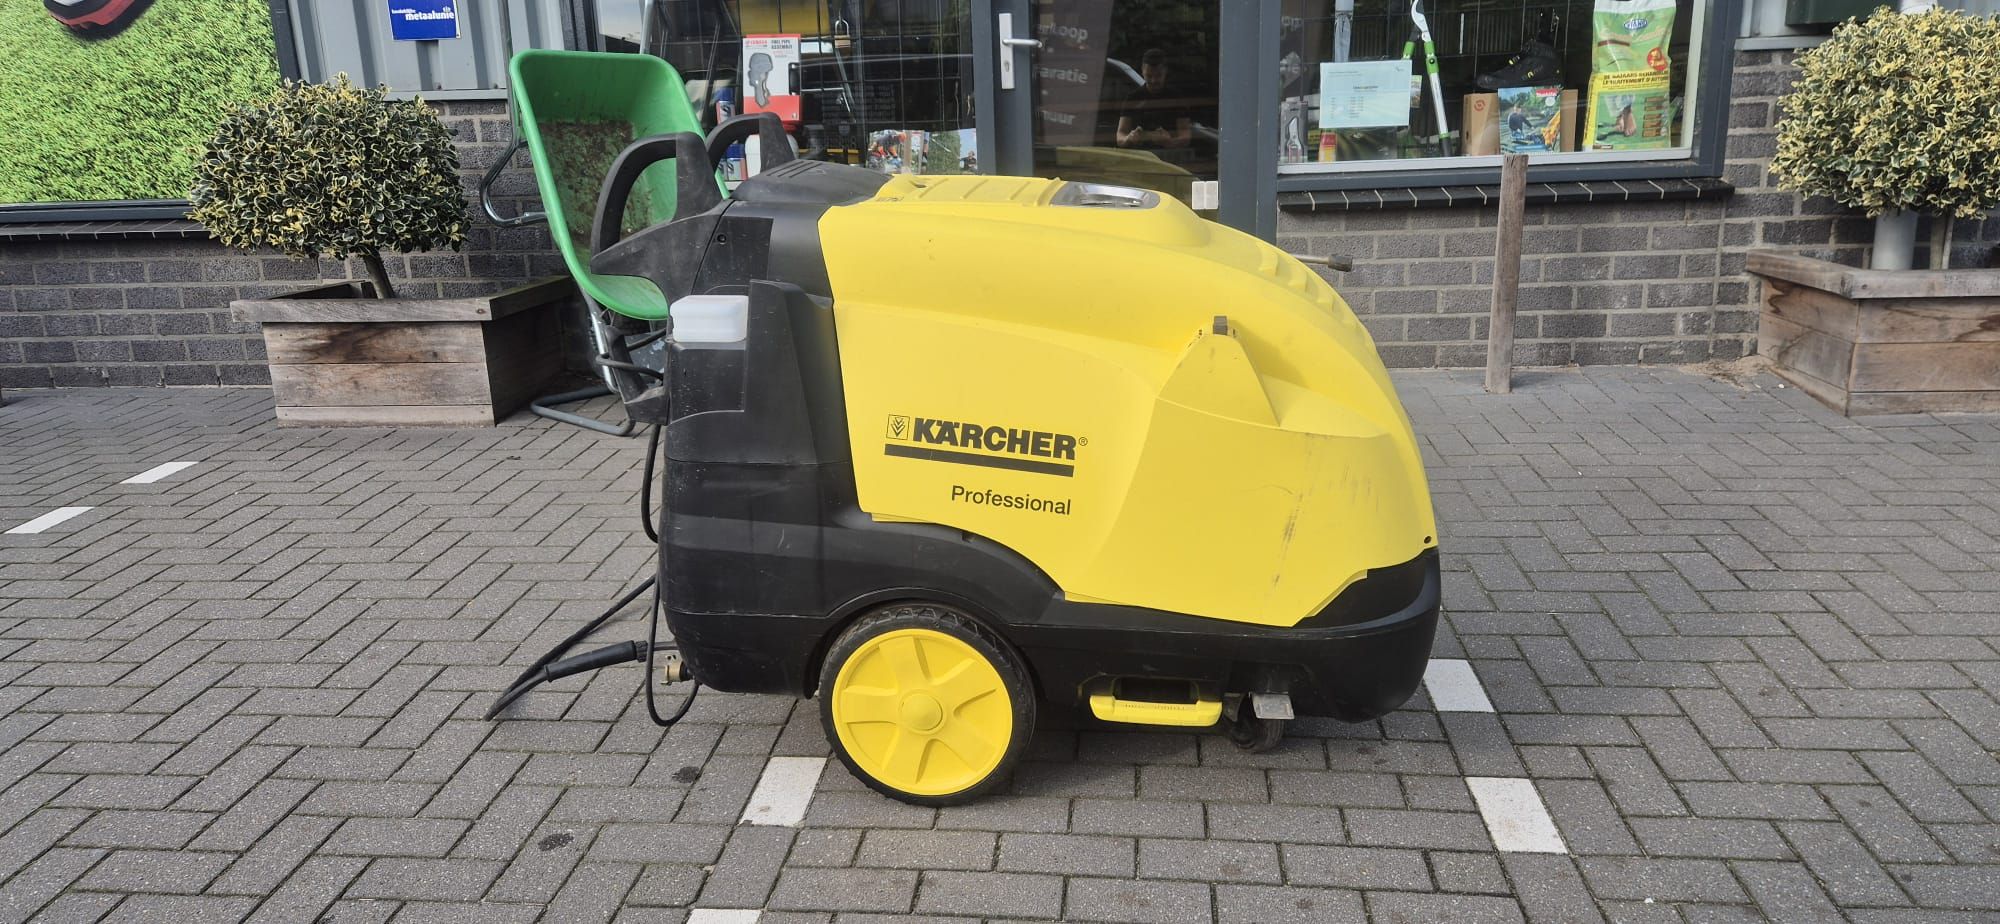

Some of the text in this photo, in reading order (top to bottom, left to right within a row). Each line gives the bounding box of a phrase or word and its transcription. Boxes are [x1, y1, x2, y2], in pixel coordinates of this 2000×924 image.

[405, 10, 455, 20] metaalunie
[913, 417, 1077, 460] KÄRCHER
[951, 485, 1072, 515] Professional
